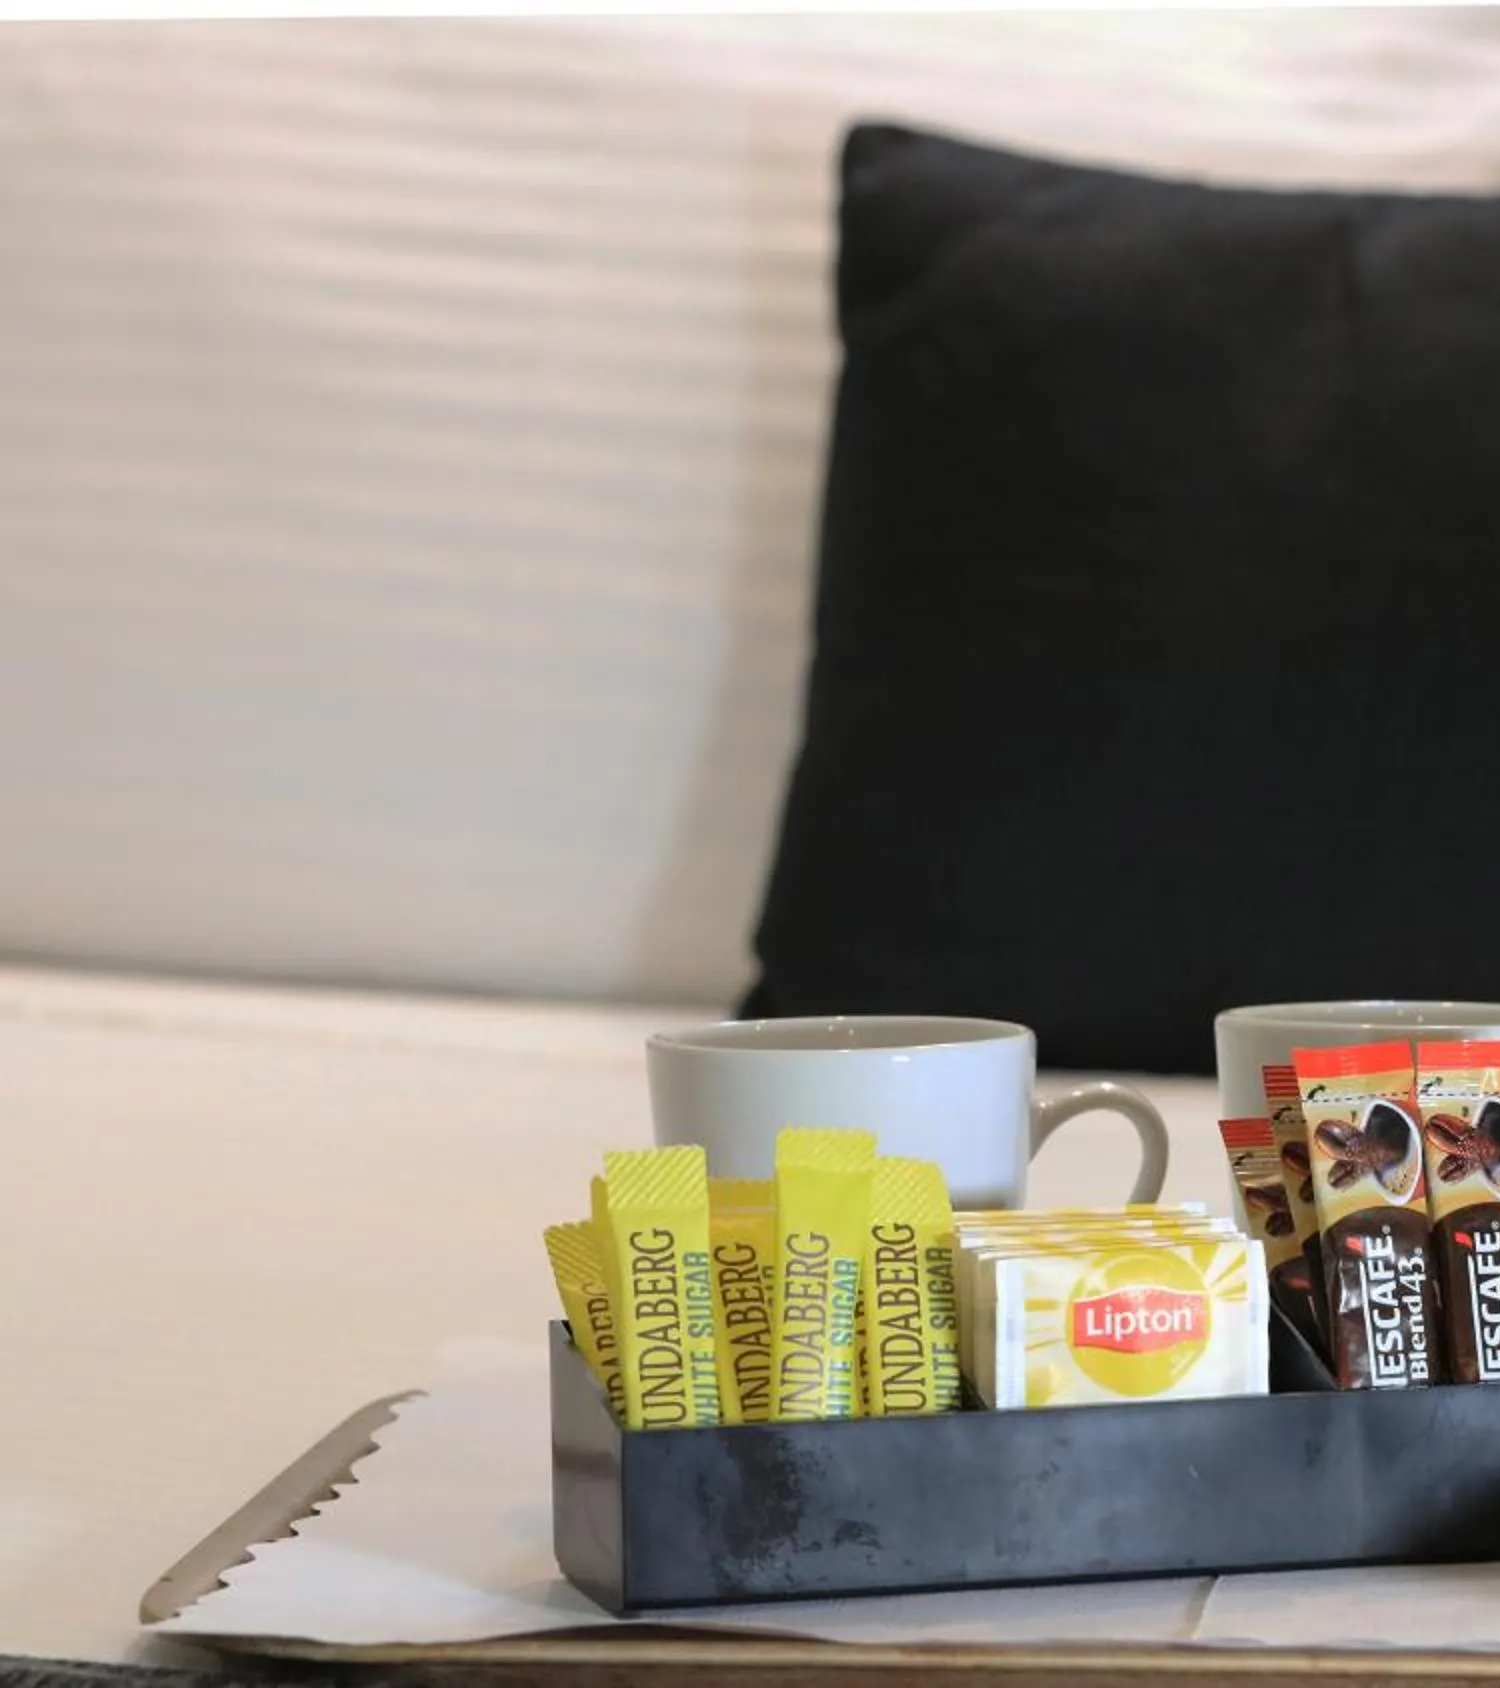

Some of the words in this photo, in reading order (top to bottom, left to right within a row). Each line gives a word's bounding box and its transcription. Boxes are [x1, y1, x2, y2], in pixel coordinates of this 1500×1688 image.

[630, 1229, 688, 1428] UNDABERG
[683, 1251, 716, 1339] SUGAR
[831, 1260, 860, 1346] SUGAR
[871, 1222, 927, 1414] UNDABERG
[926, 1246, 957, 1331] SUGAR
[1086, 1305, 1193, 1343] Lipton
[713, 1243, 771, 1424] UNDABERG
[1401, 1295, 1429, 1380] Blend
[824, 1361, 853, 1419] HITE
